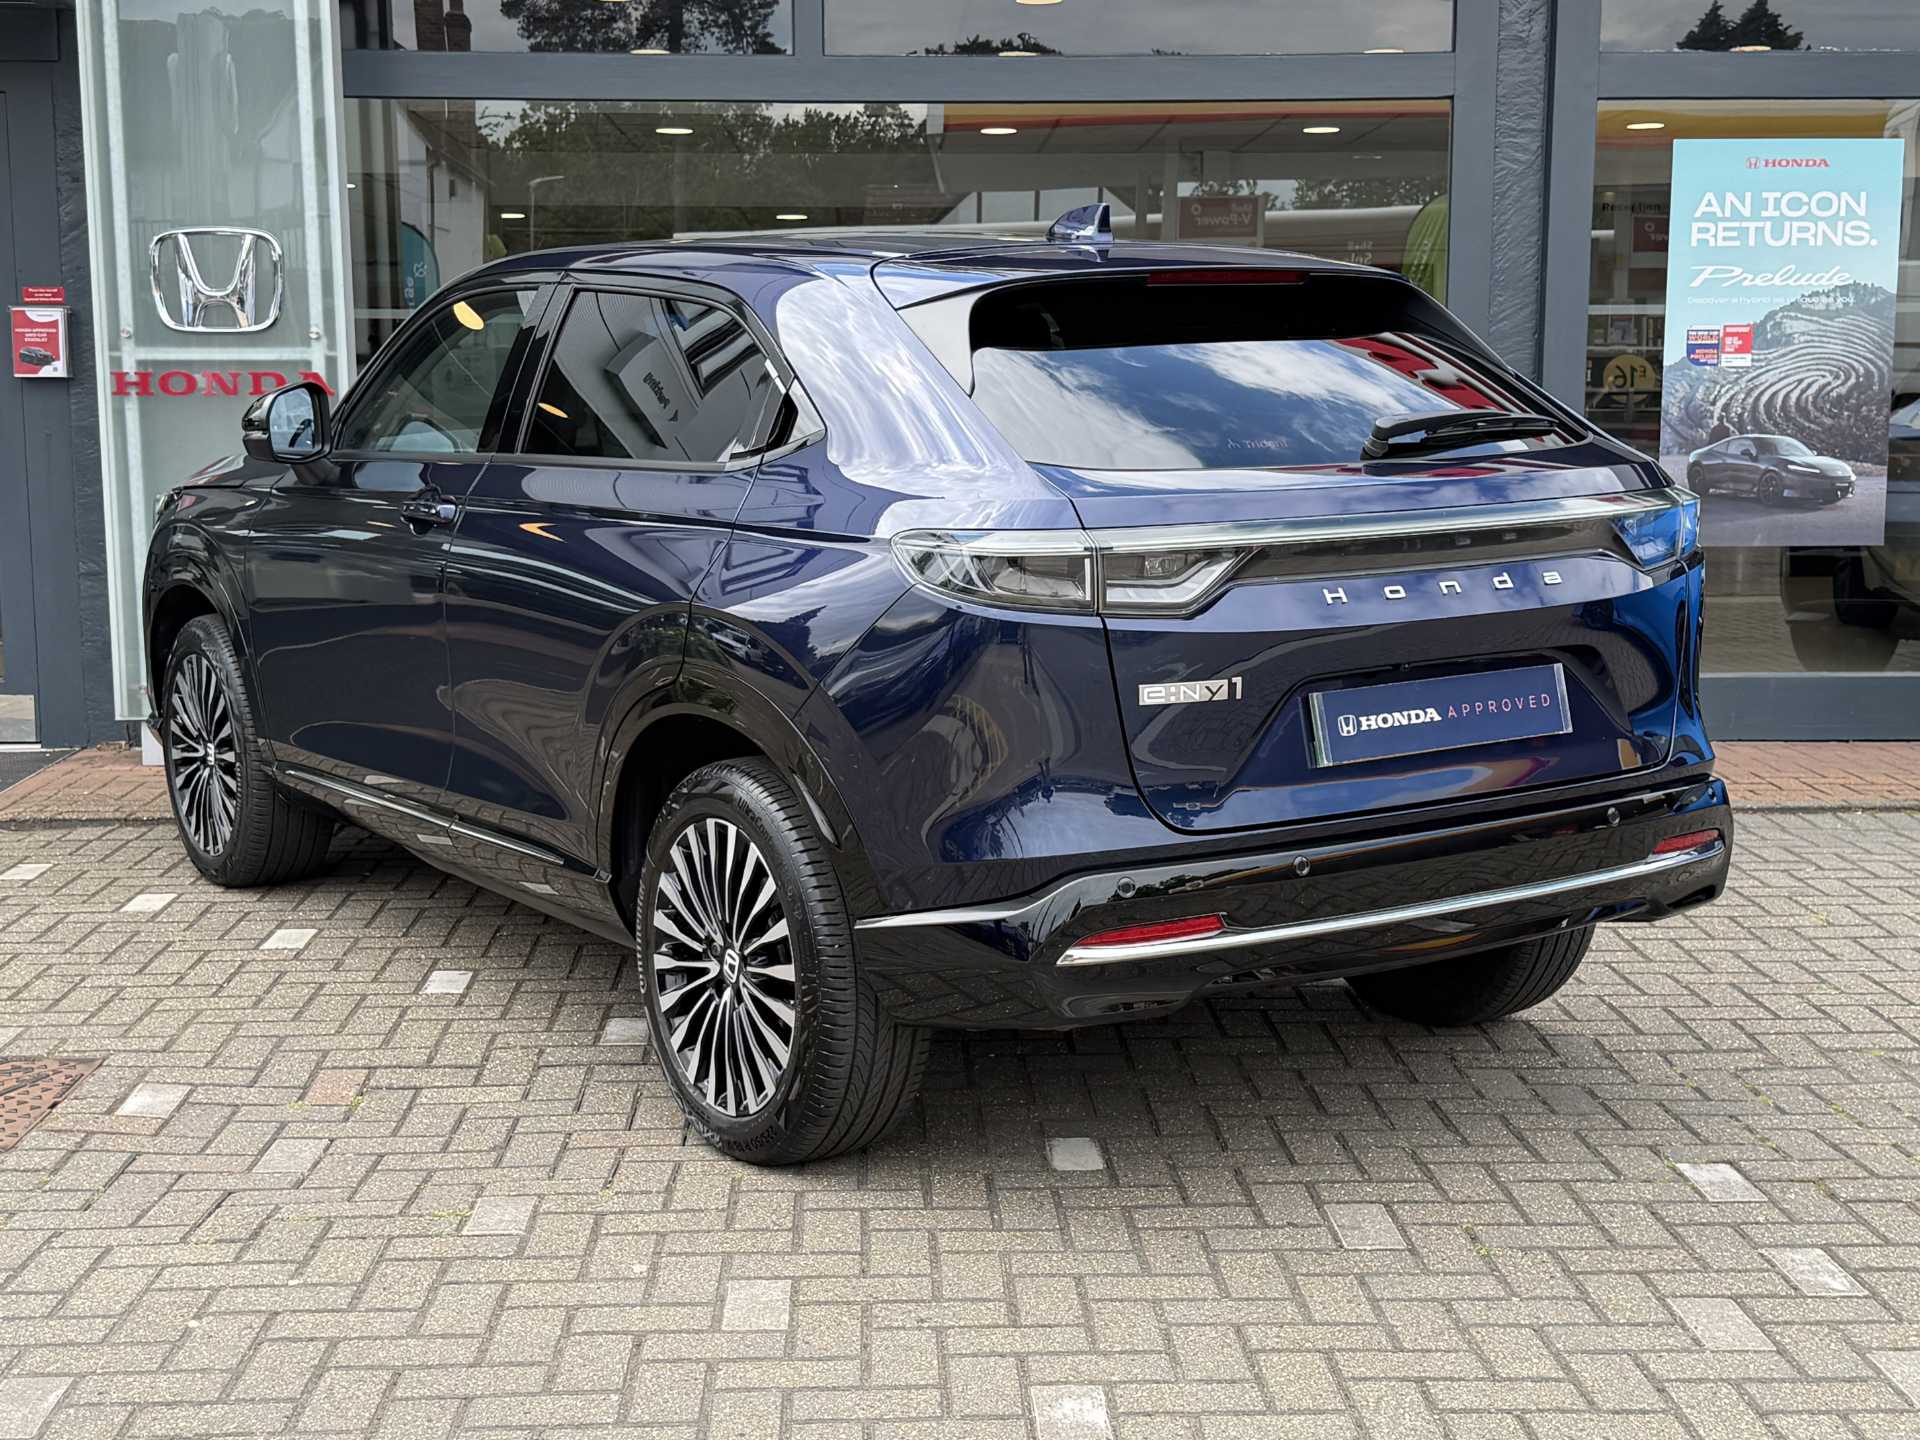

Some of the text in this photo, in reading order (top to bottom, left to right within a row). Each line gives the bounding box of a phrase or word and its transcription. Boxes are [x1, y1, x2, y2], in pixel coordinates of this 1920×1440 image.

[1764, 158, 1830, 168] HONDA
[1694, 191, 1867, 218] AN ICON
[1690, 220, 1879, 247] RETURNS.
[1689, 264, 1852, 288] Prelude
[1359, 693, 1551, 731] HONDA APPROVED
